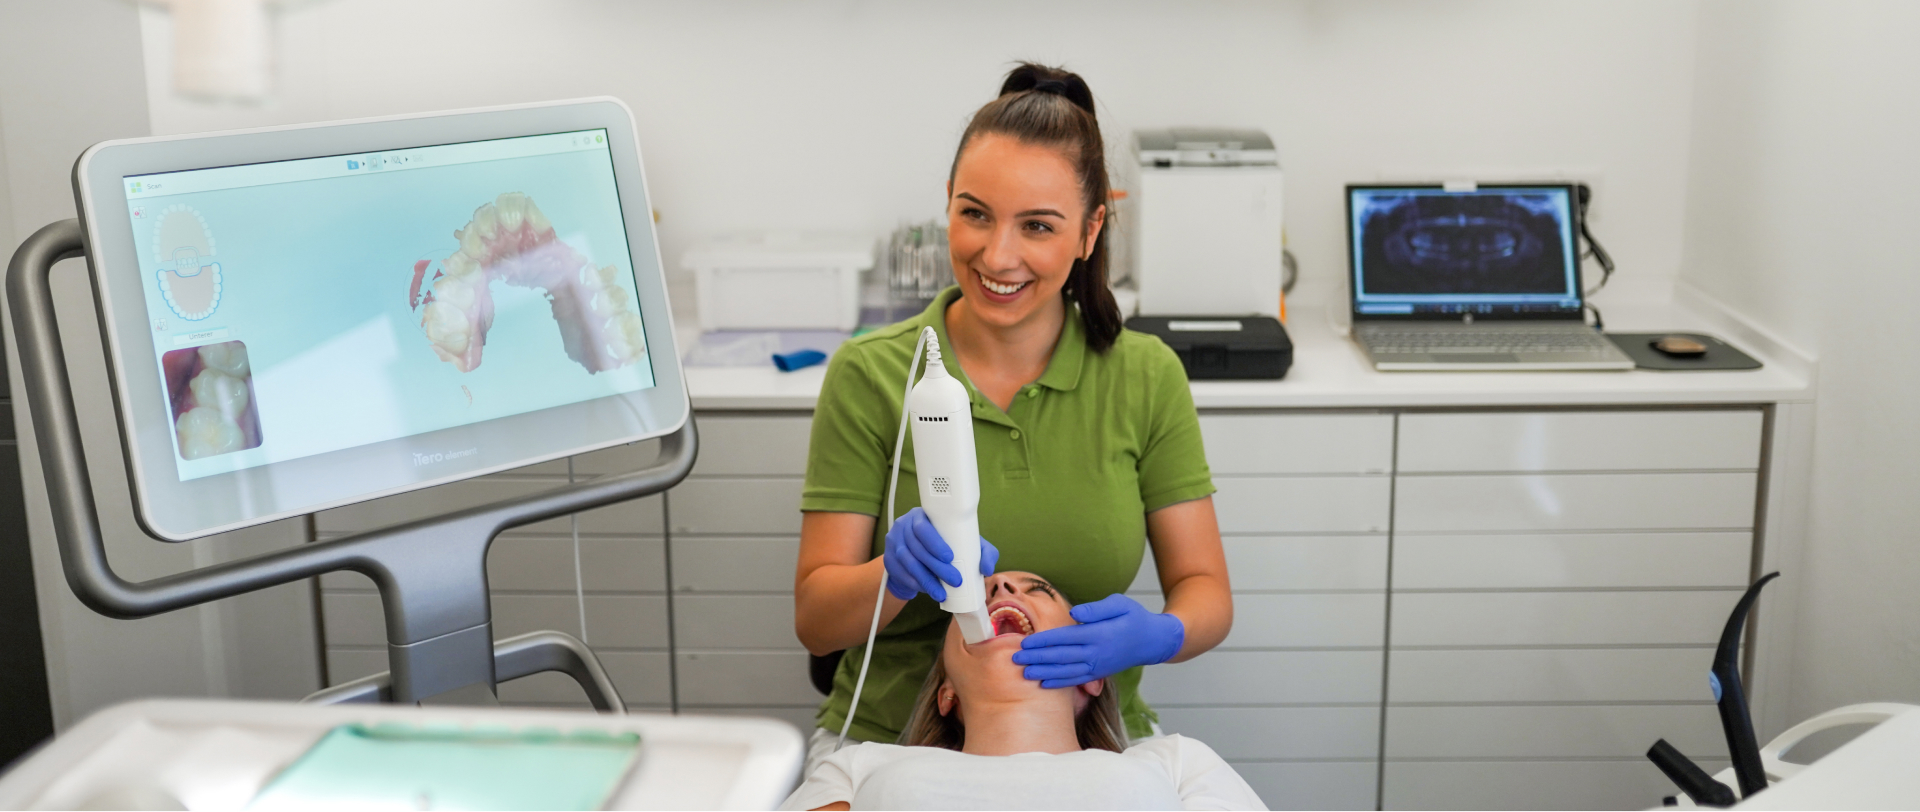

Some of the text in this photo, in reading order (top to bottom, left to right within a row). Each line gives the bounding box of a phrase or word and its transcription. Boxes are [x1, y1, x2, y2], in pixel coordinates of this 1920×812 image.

[189, 331, 213, 340] Unterer
[412, 447, 477, 467] iTero element
